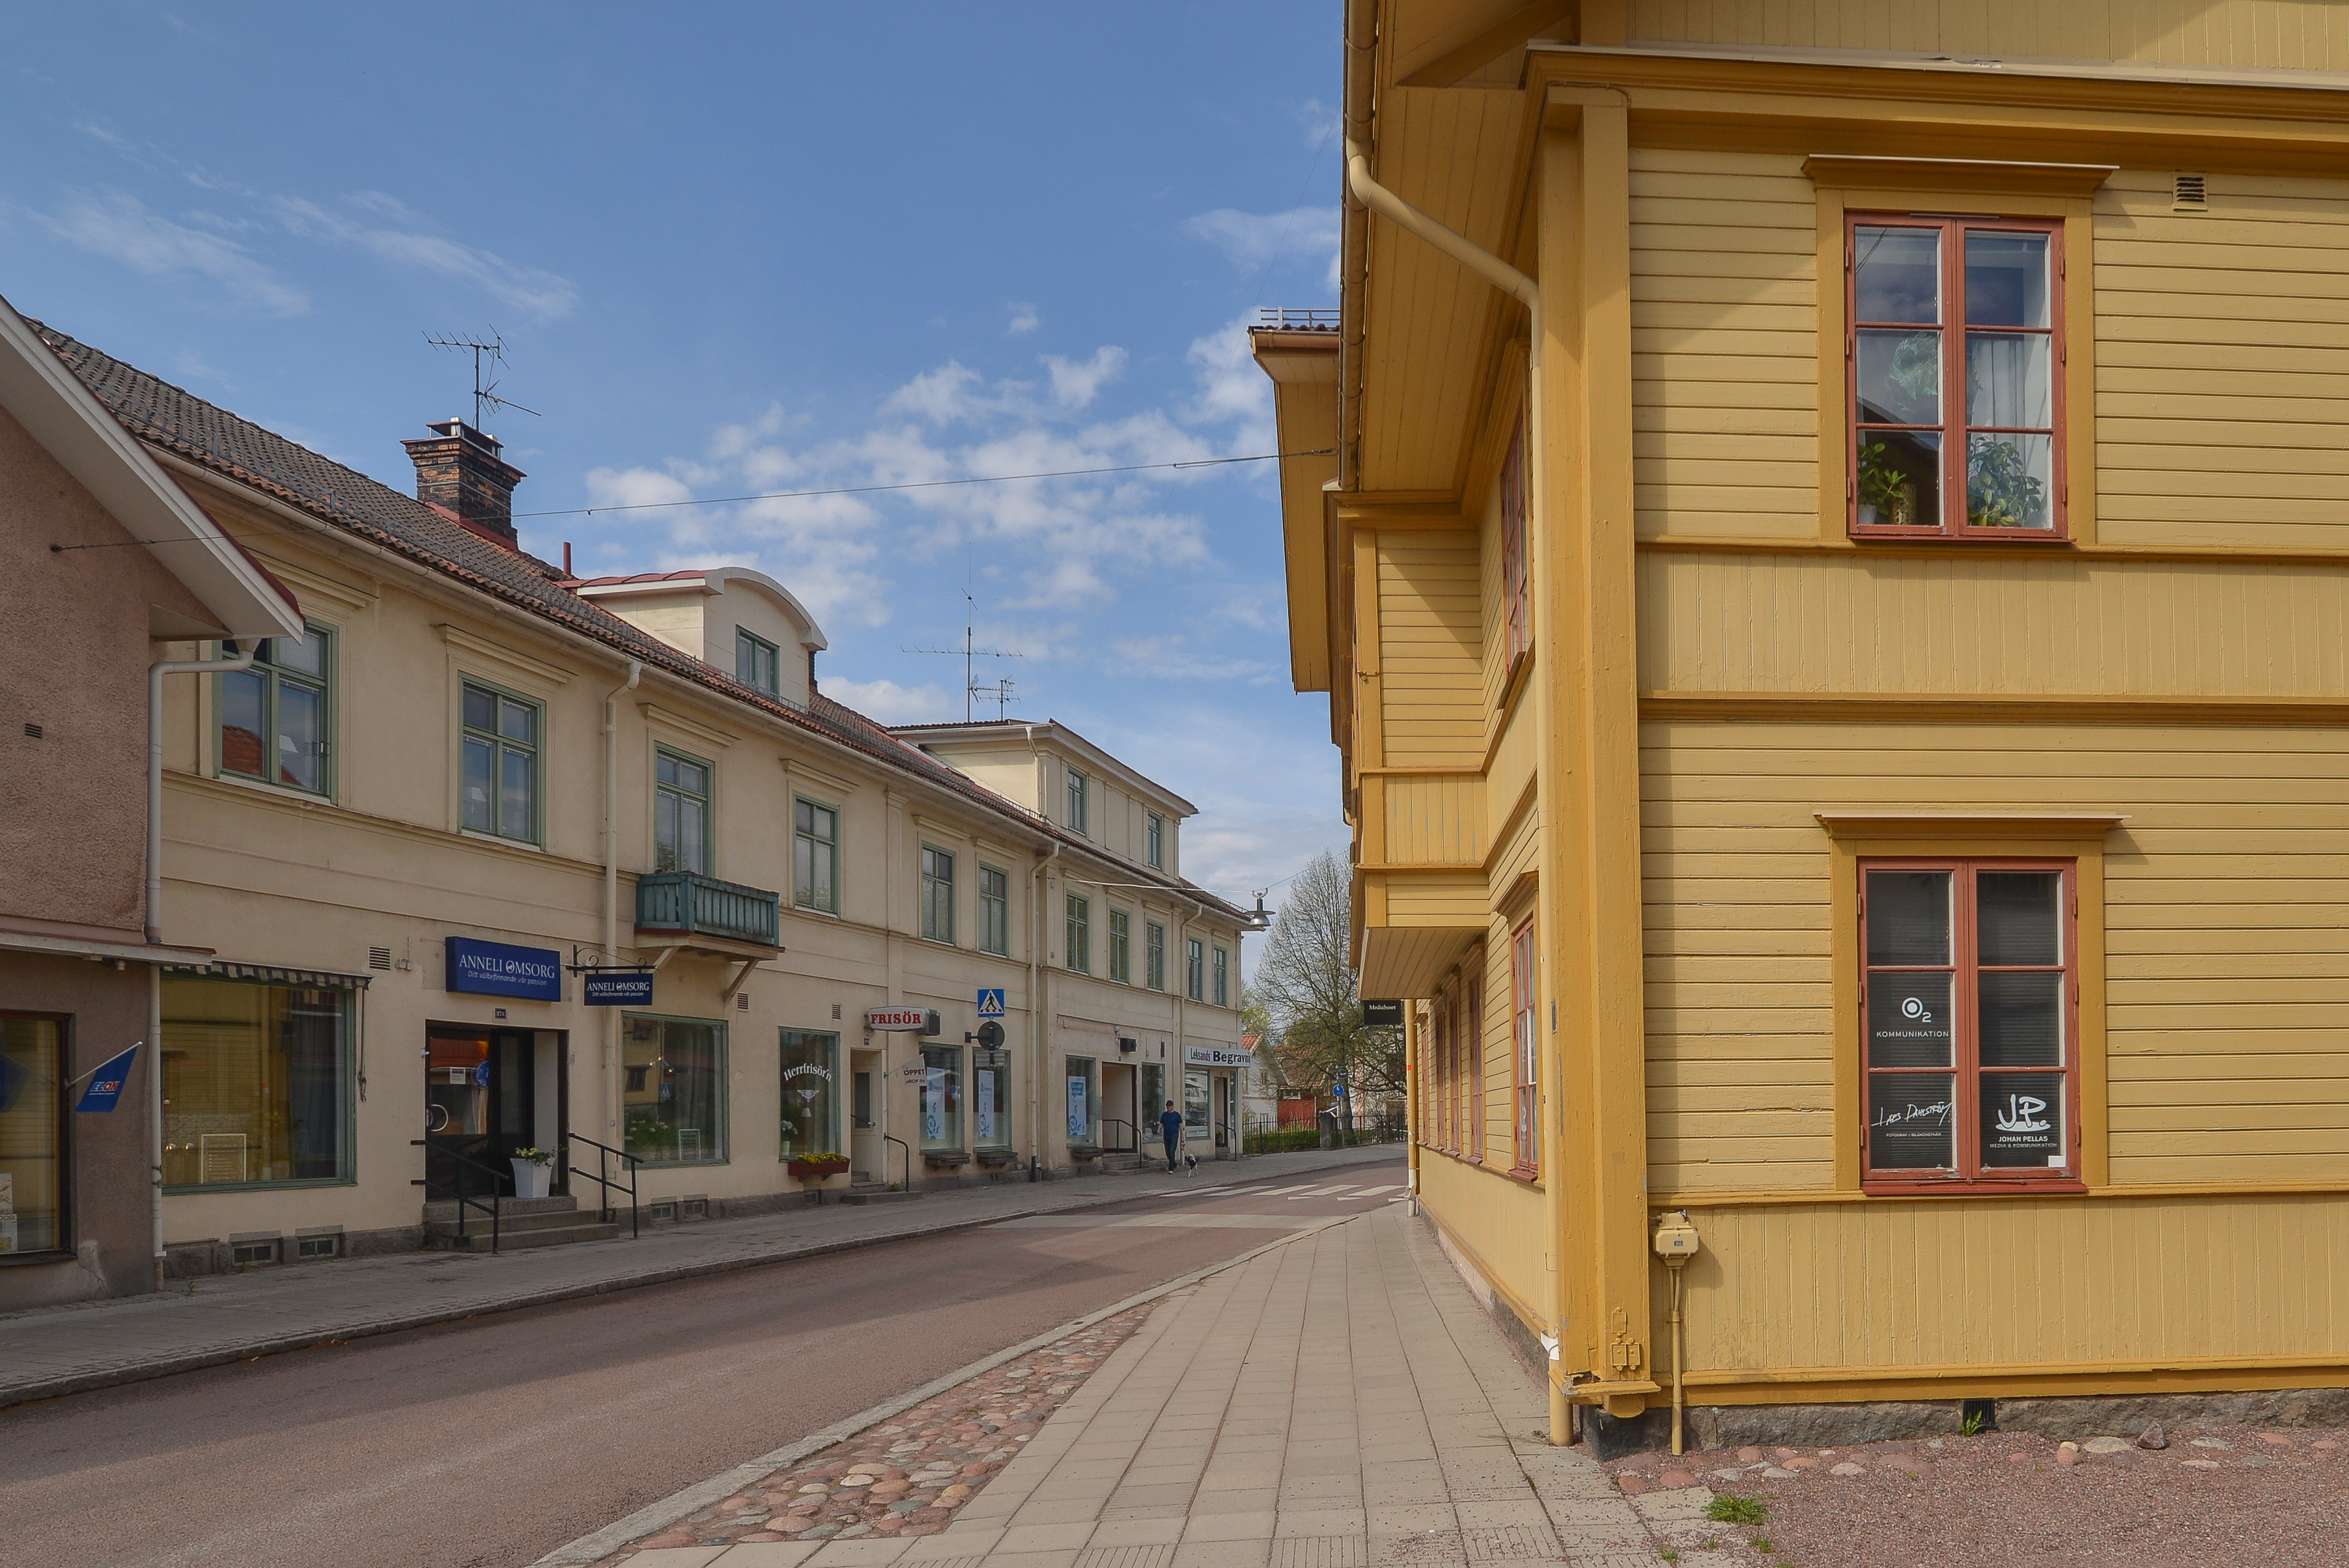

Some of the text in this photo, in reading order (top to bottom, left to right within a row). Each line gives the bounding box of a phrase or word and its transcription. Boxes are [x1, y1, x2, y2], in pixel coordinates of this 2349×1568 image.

[459, 954, 555, 979] ANNELI OMSORG
[479, 972, 517, 982] välbefinnande
[587, 982, 649, 991] ANNELI OMSORG
[871, 1011, 921, 1024] FRISÖR
[90, 1081, 120, 1092] ELON
